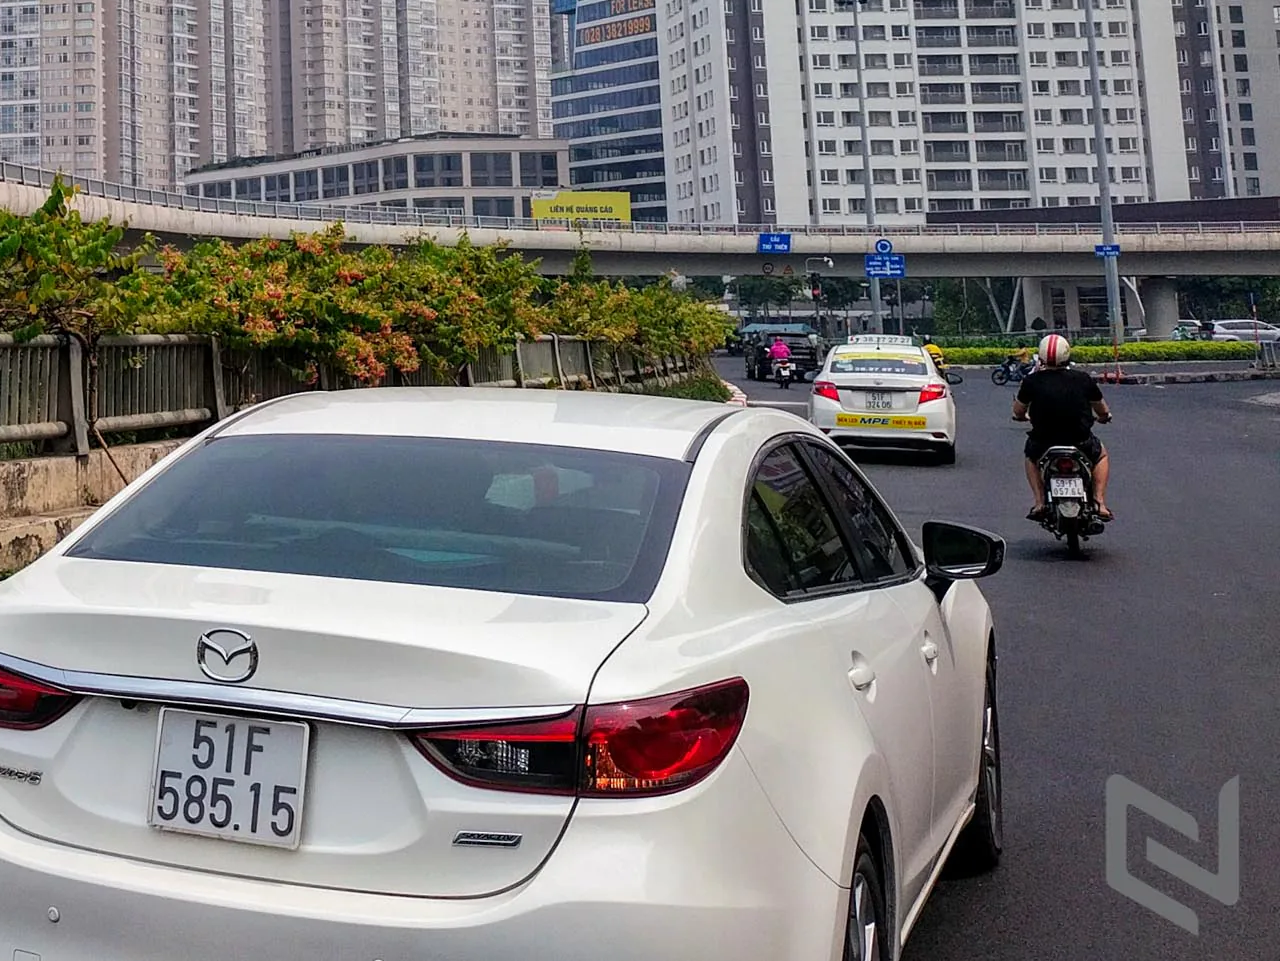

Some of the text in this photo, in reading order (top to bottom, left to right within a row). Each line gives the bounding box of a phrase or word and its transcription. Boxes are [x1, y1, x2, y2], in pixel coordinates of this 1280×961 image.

[607, 16, 651, 40] 38219999
[549, 205, 564, 213] LIÊN
[576, 204, 598, 214] QUẢNG
[599, 205, 613, 213] CÁO
[860, 417, 891, 425] MPE
[191, 719, 270, 776] 51F
[157, 769, 297, 837] 585.15
